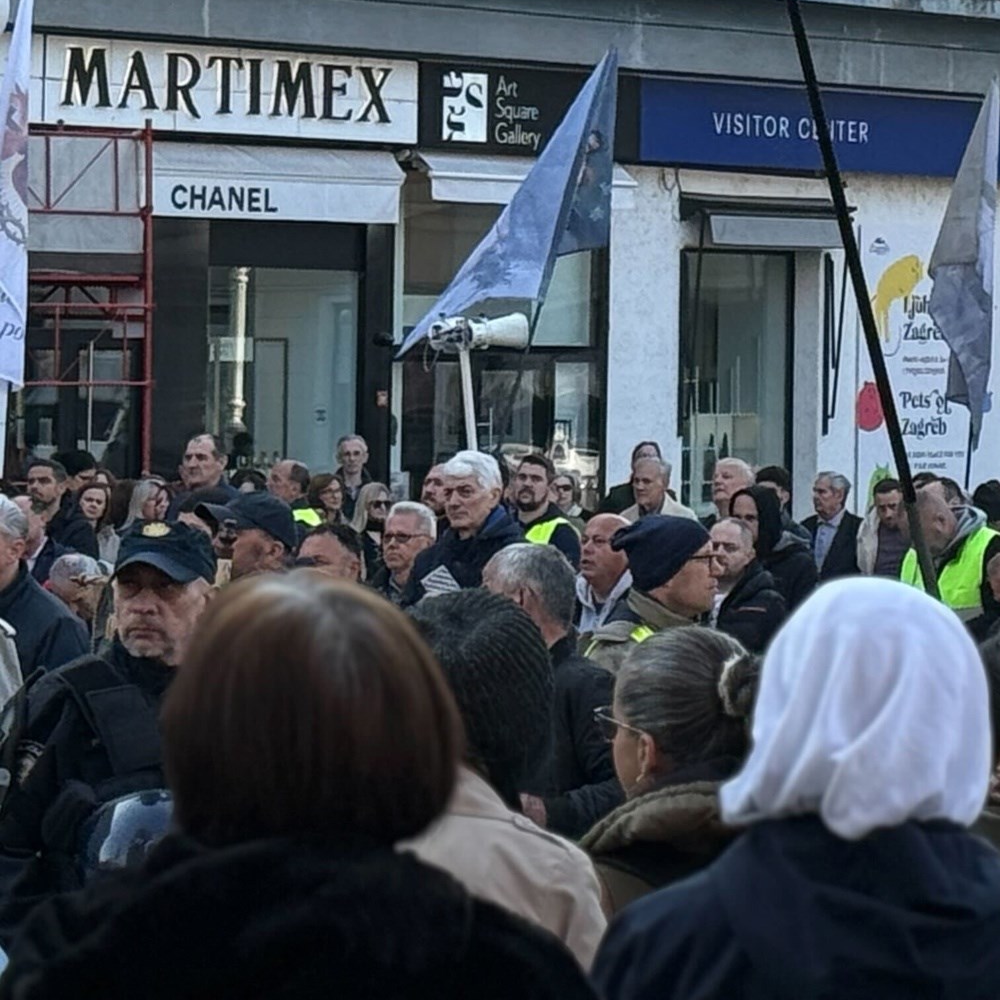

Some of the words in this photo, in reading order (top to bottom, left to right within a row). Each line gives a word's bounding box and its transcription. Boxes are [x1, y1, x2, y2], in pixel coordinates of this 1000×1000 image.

[60, 46, 392, 124] MARTIMEX
[495, 75, 518, 98] Art
[494, 97, 539, 124] Square
[495, 122, 541, 151] Gallery
[712, 112, 790, 138] VISITOR
[171, 183, 278, 213] CHANEL
[900, 416, 947, 440] Zagreb
